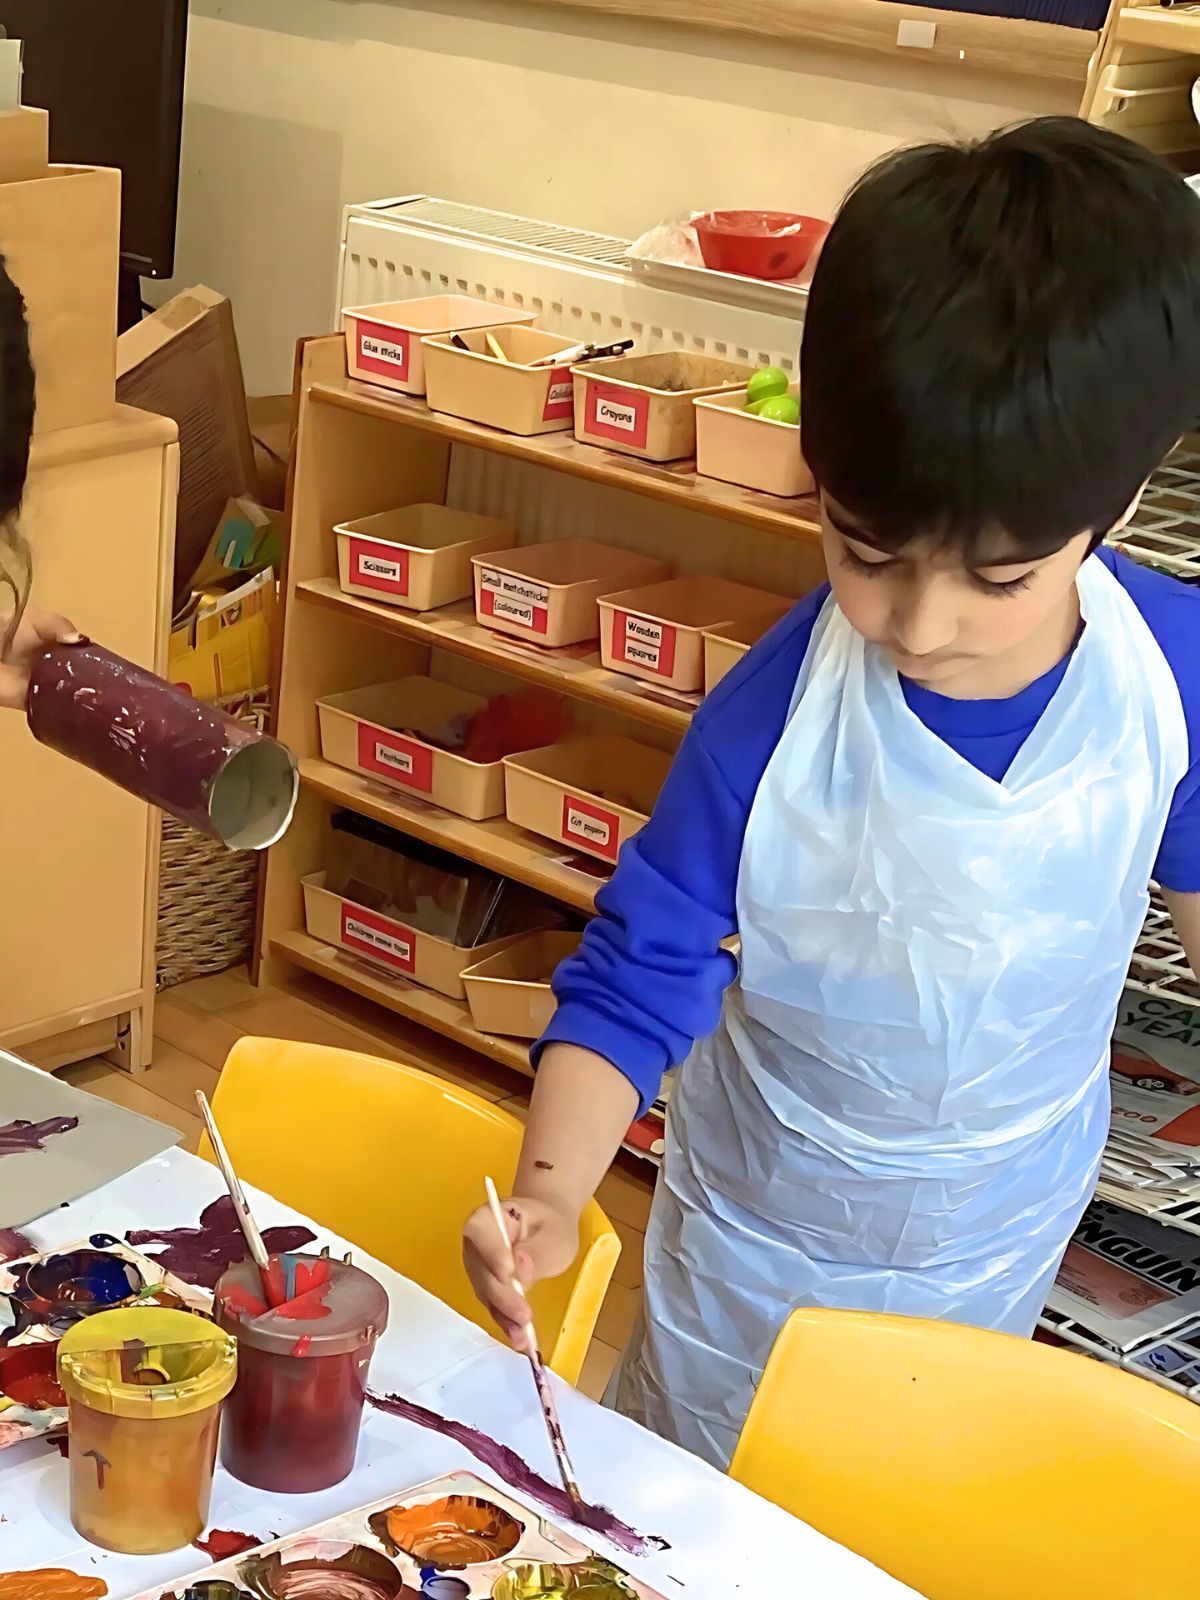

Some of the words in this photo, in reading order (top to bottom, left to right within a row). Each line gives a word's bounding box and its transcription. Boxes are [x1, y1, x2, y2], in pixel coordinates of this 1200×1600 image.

[600, 404, 633, 423] Crayons
[1122, 1011, 1200, 1048] YEA
[1138, 999, 1200, 1029] CA
[1072, 1219, 1200, 1292] NGUIN
